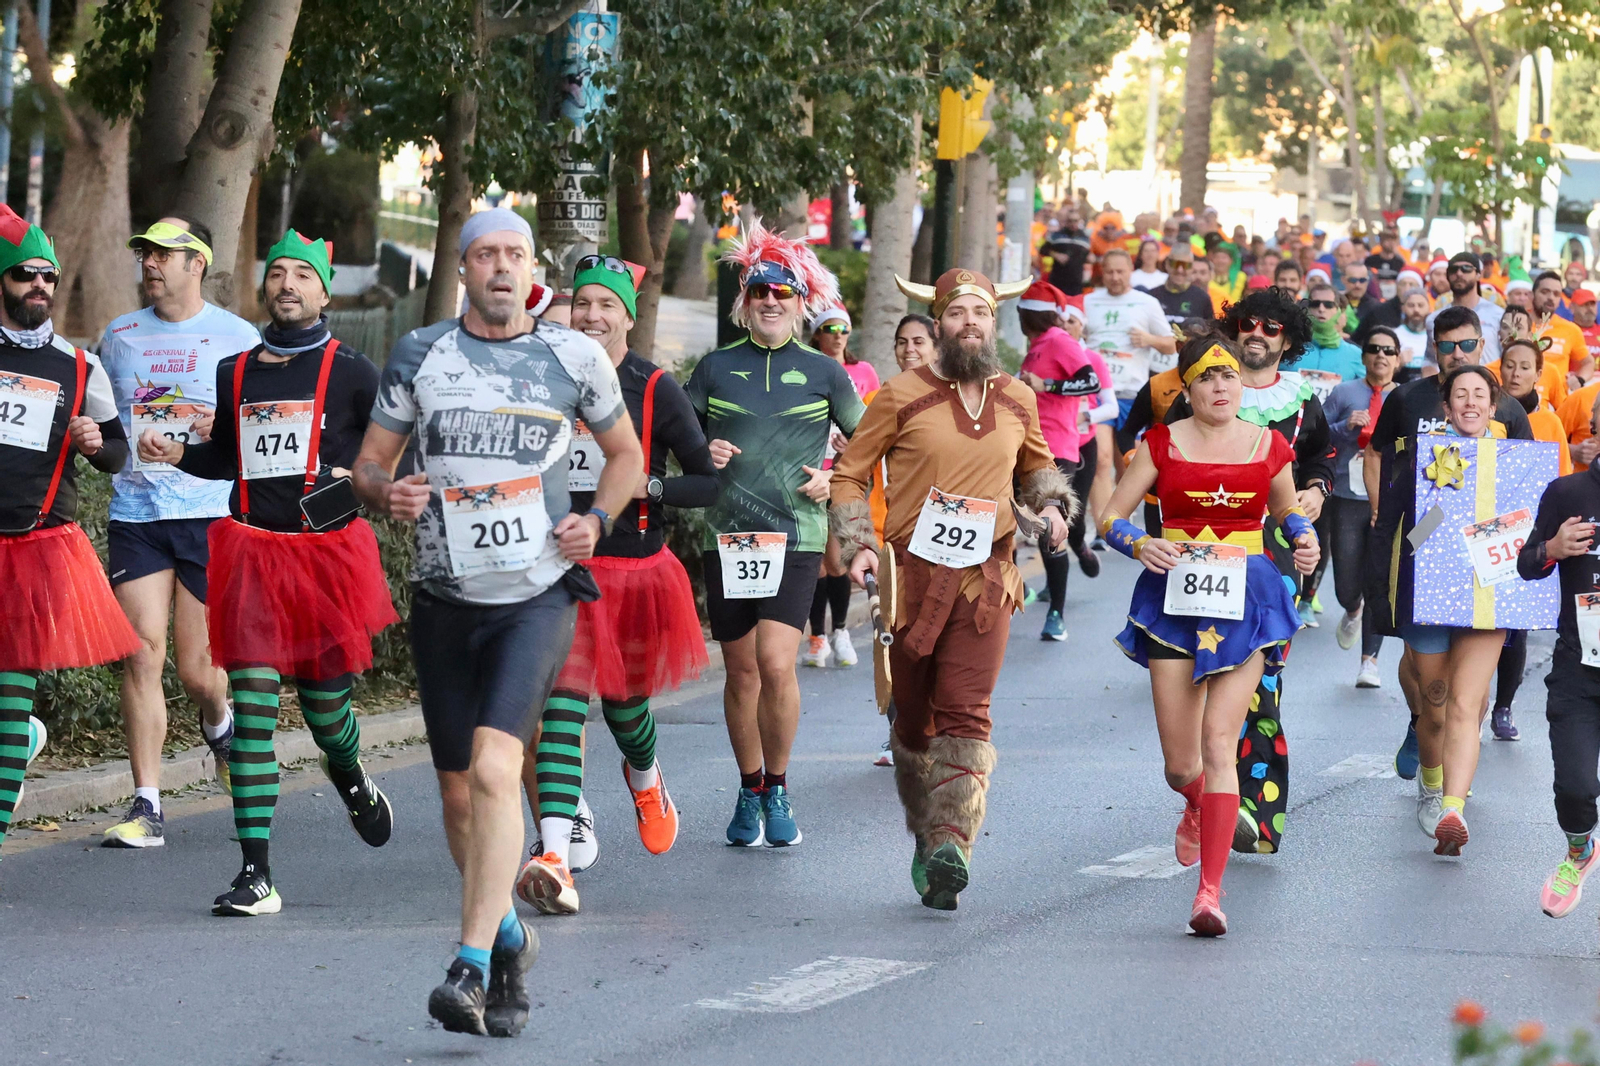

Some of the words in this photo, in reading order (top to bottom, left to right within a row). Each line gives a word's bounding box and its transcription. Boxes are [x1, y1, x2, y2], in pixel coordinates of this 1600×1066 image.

[567, 203, 577, 219] 5
[581, 204, 605, 219] DIC
[150, 362, 184, 373] MÁLAGA
[255, 432, 299, 457] 474
[440, 431, 516, 457] TRAIL
[471, 516, 529, 549] 201
[931, 522, 977, 551] 292
[736, 560, 771, 580] 337
[1183, 572, 1230, 597] 844
